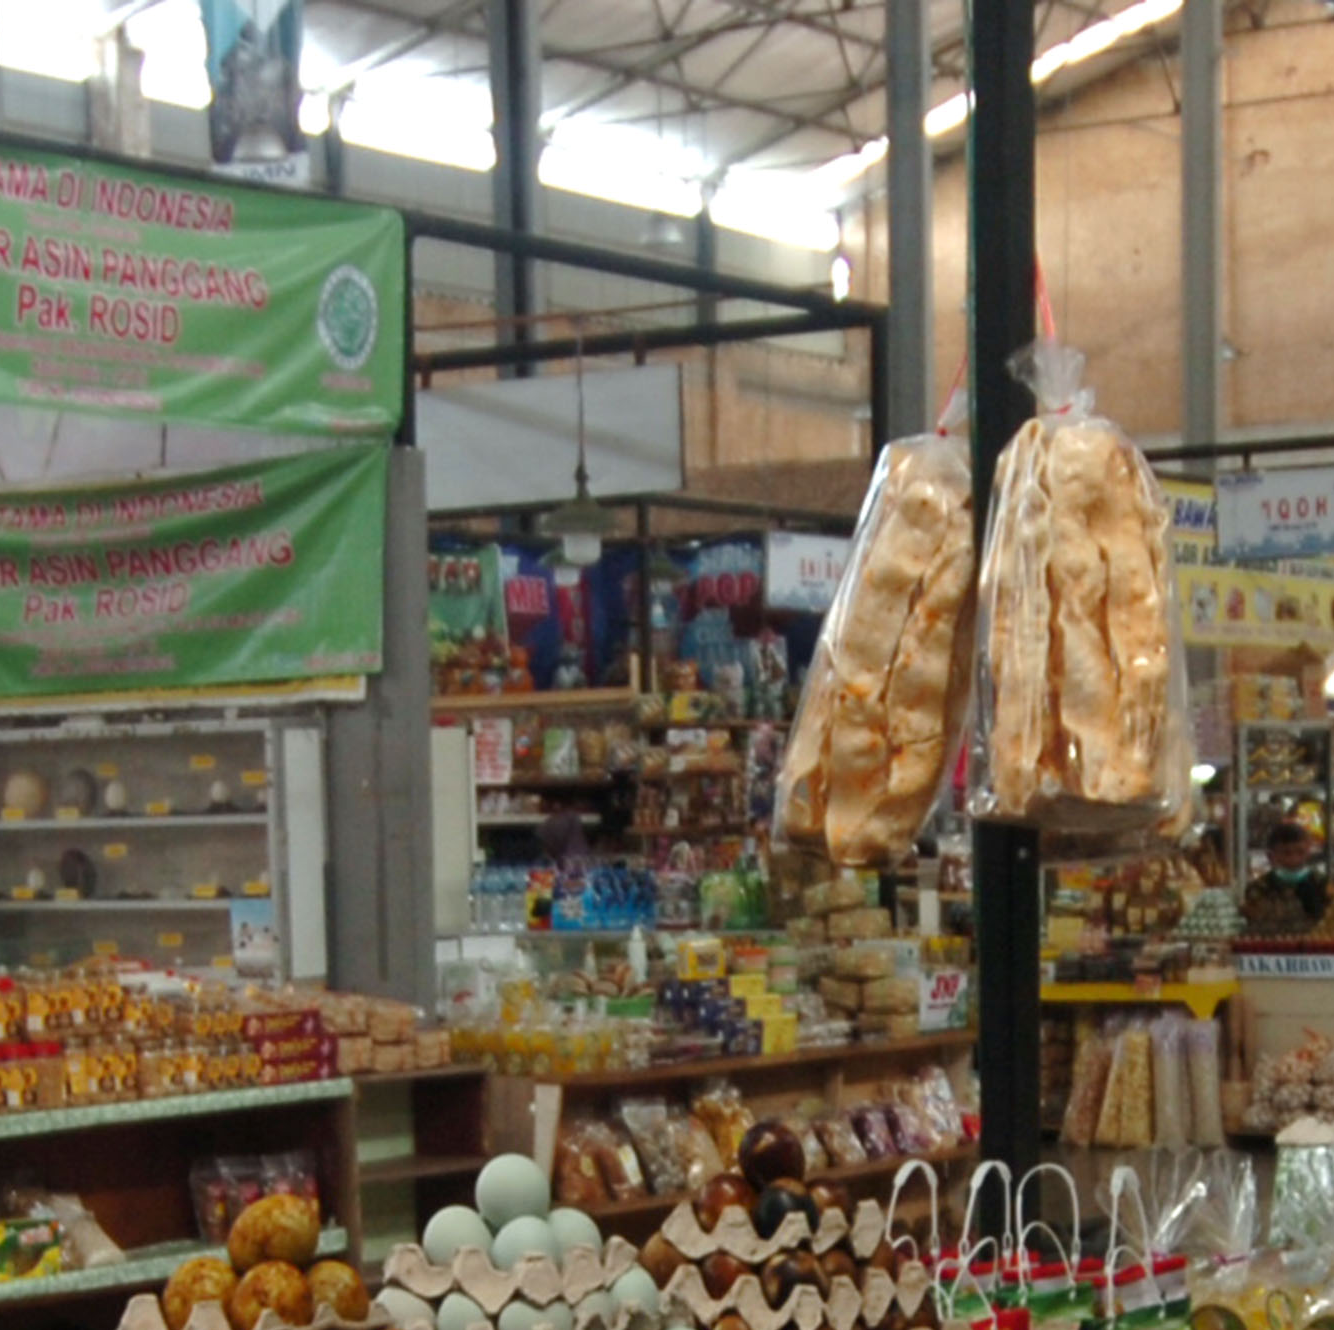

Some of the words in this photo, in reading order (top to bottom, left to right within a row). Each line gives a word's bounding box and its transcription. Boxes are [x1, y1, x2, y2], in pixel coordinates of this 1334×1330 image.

[57, 171, 84, 210] DI
[94, 180, 235, 233] INDONESIA
[21, 234, 92, 284] ASIN
[101, 247, 269, 310] PANGGANG
[88, 295, 181, 345] ROSID
[75, 500, 104, 528] DI
[111, 481, 264, 524] INDONESIA
[29, 551, 101, 588] ASIN
[104, 530, 296, 580] PANGGANG
[94, 582, 190, 620] ROSID
